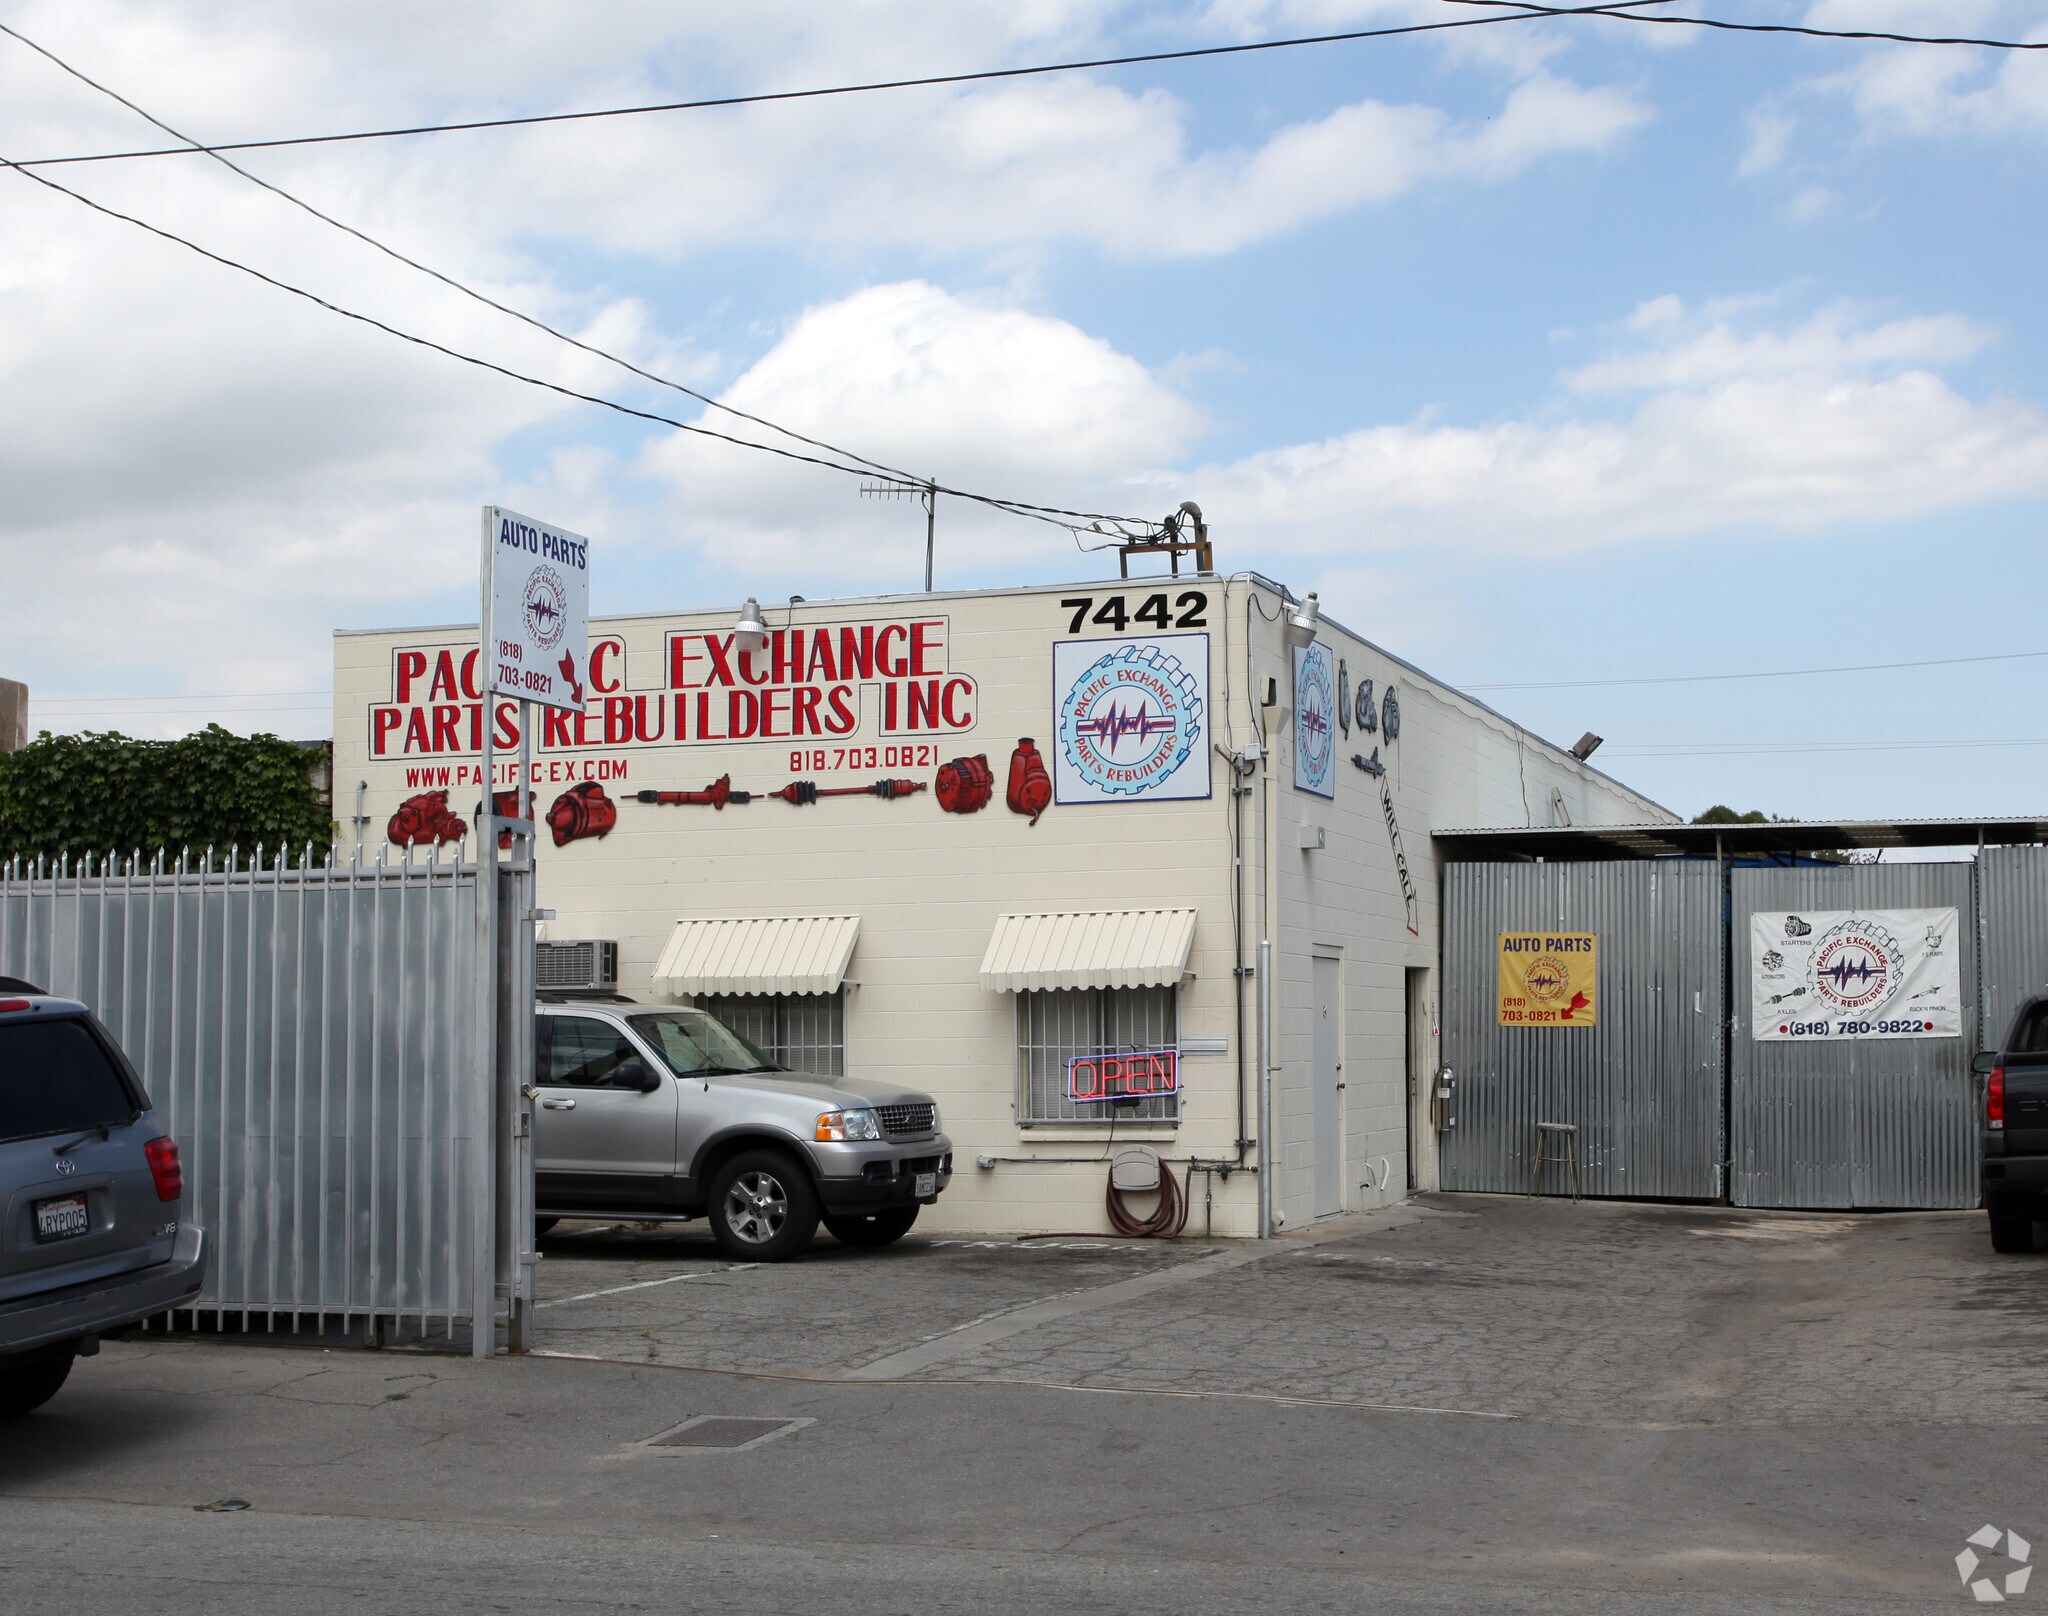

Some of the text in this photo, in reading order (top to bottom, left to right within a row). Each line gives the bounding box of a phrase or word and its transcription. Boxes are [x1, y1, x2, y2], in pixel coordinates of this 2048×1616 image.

[500, 518, 586, 570] AUTO PARTS
[526, 575, 562, 609] PACIFIC EXCHANGE
[526, 613, 538, 638] PARTS
[1061, 591, 1208, 634] 7442
[396, 621, 945, 704] PACC EXCHANGE
[499, 640, 523, 663] (818)
[497, 663, 553, 694] 703-0821
[1074, 669, 1178, 718] PACIFIC EXCHANGE
[374, 678, 973, 755] PARTS REBUILDERS INC
[789, 745, 939, 772] 818.703.0821
[1074, 734, 1178, 782] PARTS REBUILDERS
[1383, 789, 1413, 909] WILL CALL
[1503, 937, 1592, 953] AUTO PARTS
[1817, 936, 1888, 967] PACIFIC EXCHANGE
[1503, 997, 1526, 1008] (818)
[1816, 978, 1888, 1008] PARTS REBUILDERS
[1502, 1010, 1556, 1021] 703-0821
[1789, 1019, 1923, 1036] (818) 780-9822
[1072, 1052, 1174, 1099] OPEN
[40, 1208, 87, 1234] 4RYP005
[163, 1222, 176, 1234] V8
